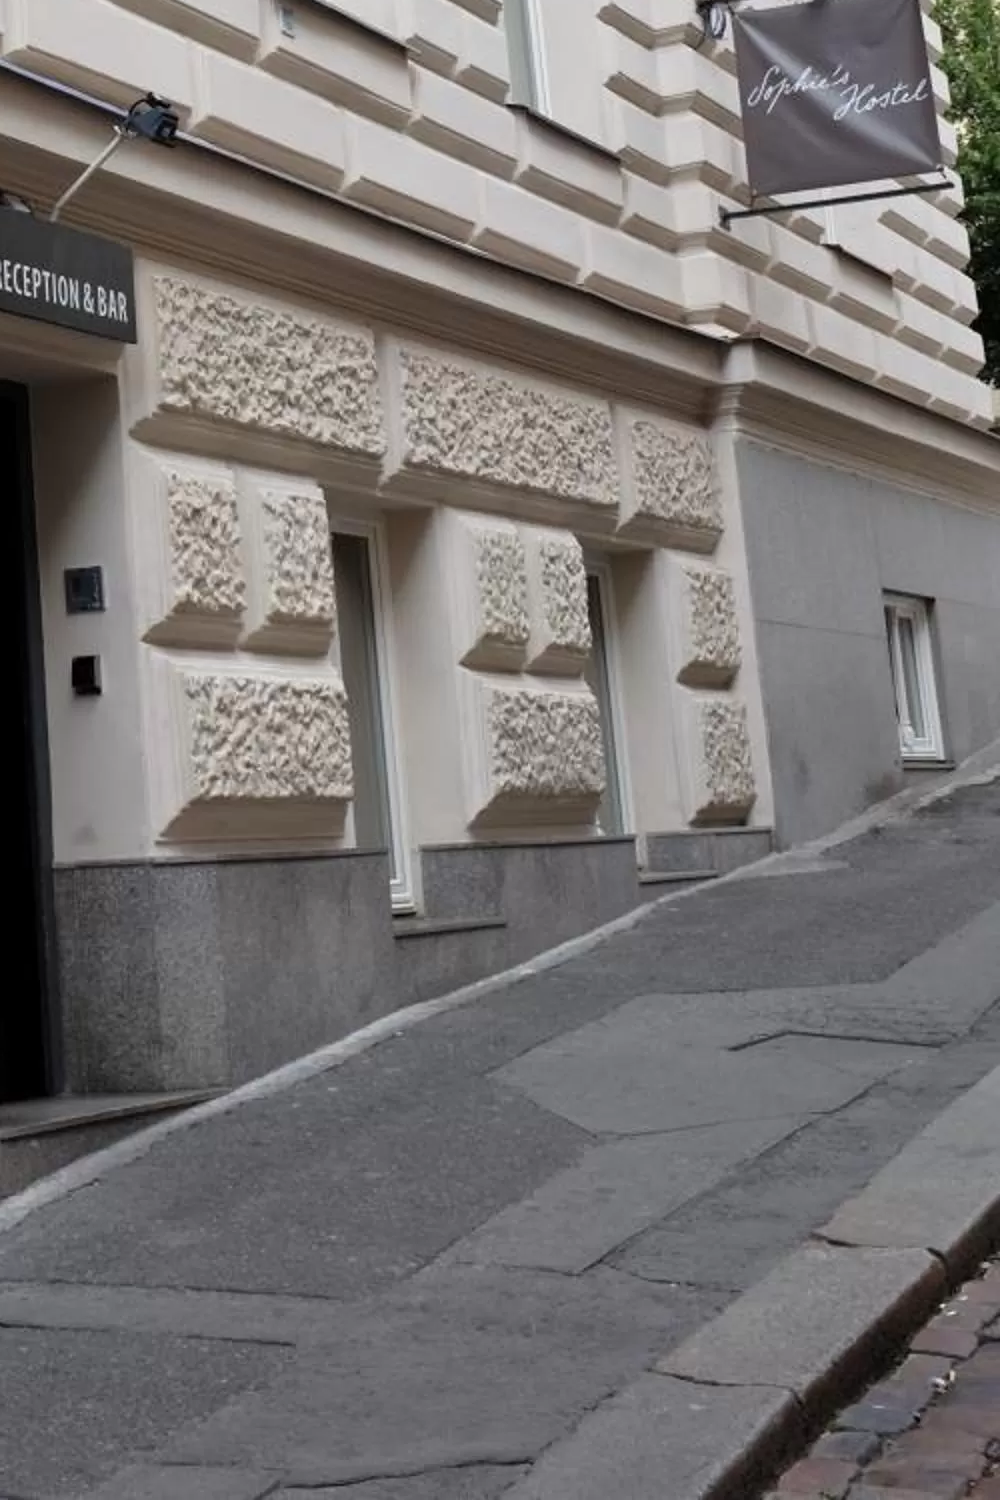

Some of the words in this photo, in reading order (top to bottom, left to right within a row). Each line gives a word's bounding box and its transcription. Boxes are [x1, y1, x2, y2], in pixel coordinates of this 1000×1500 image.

[748, 64, 850, 115] Sophie's
[833, 79, 928, 120] Hostel
[83, 282, 95, 314] &
[97, 285, 128, 324] BAR
